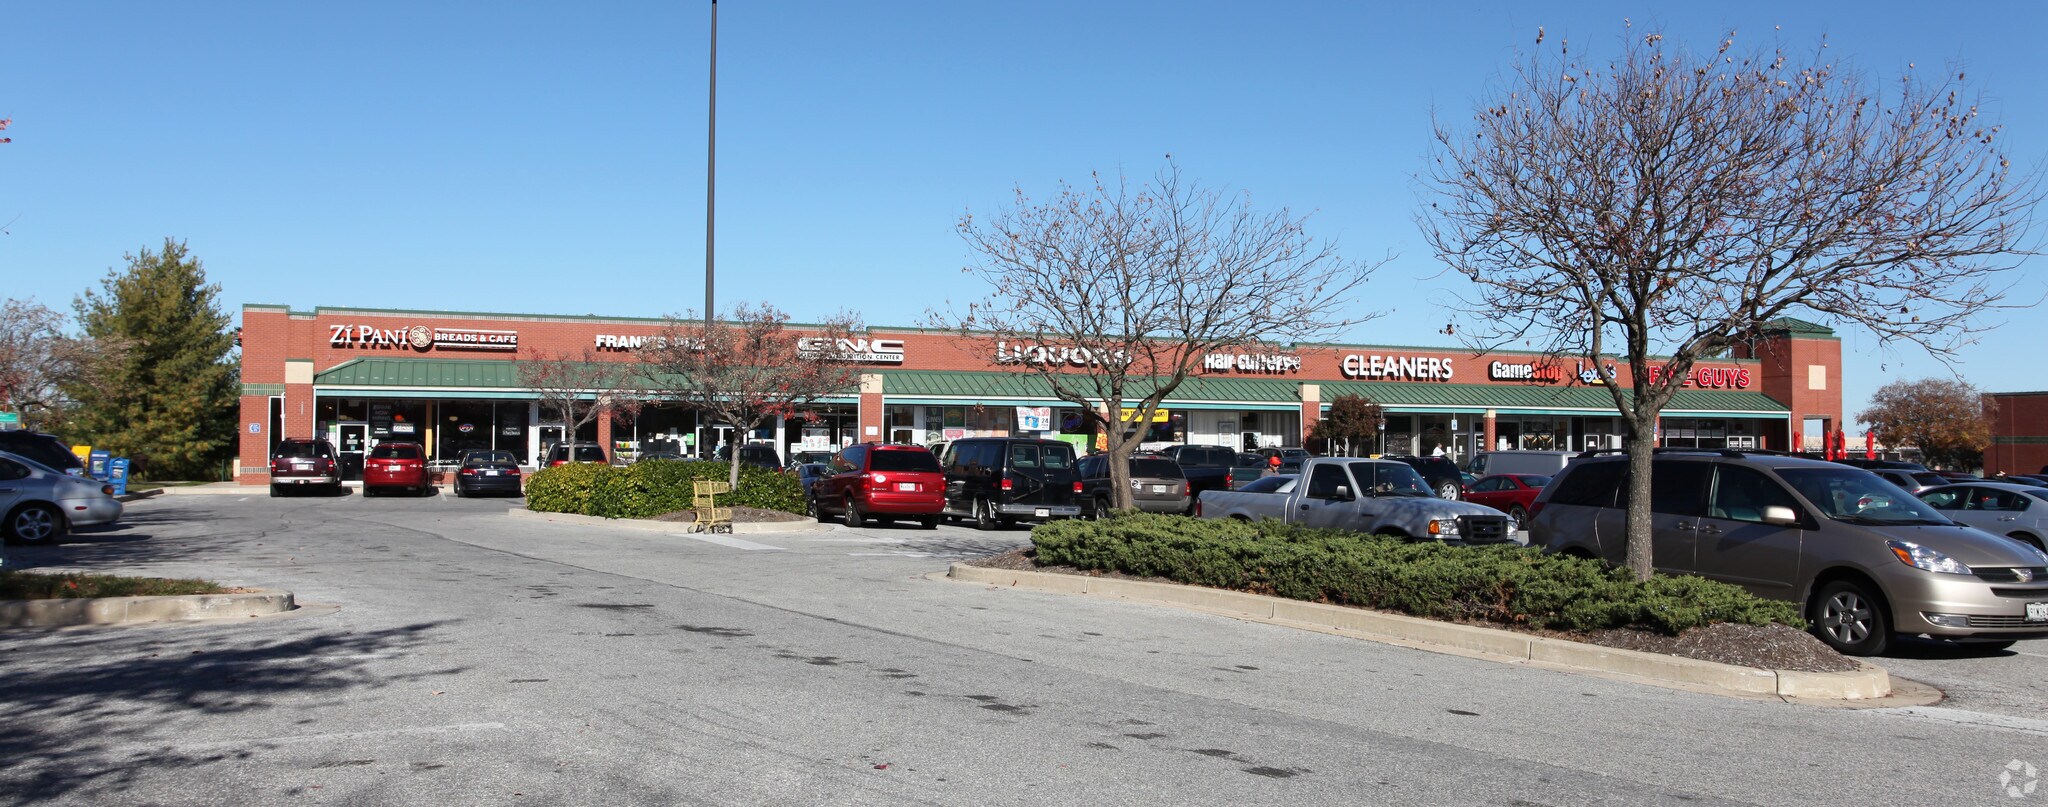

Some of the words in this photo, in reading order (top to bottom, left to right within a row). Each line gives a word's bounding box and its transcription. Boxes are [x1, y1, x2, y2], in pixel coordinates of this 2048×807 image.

[434, 332, 478, 342] BREADS
[479, 332, 486, 342] &
[489, 334, 517, 343] CAFE
[1204, 353, 1235, 369] Hair
[1343, 354, 1454, 379] CLEANERS
[1491, 359, 1562, 381] GameStop
[1648, 365, 1693, 386] FE
[1698, 366, 1751, 387] GUYS
